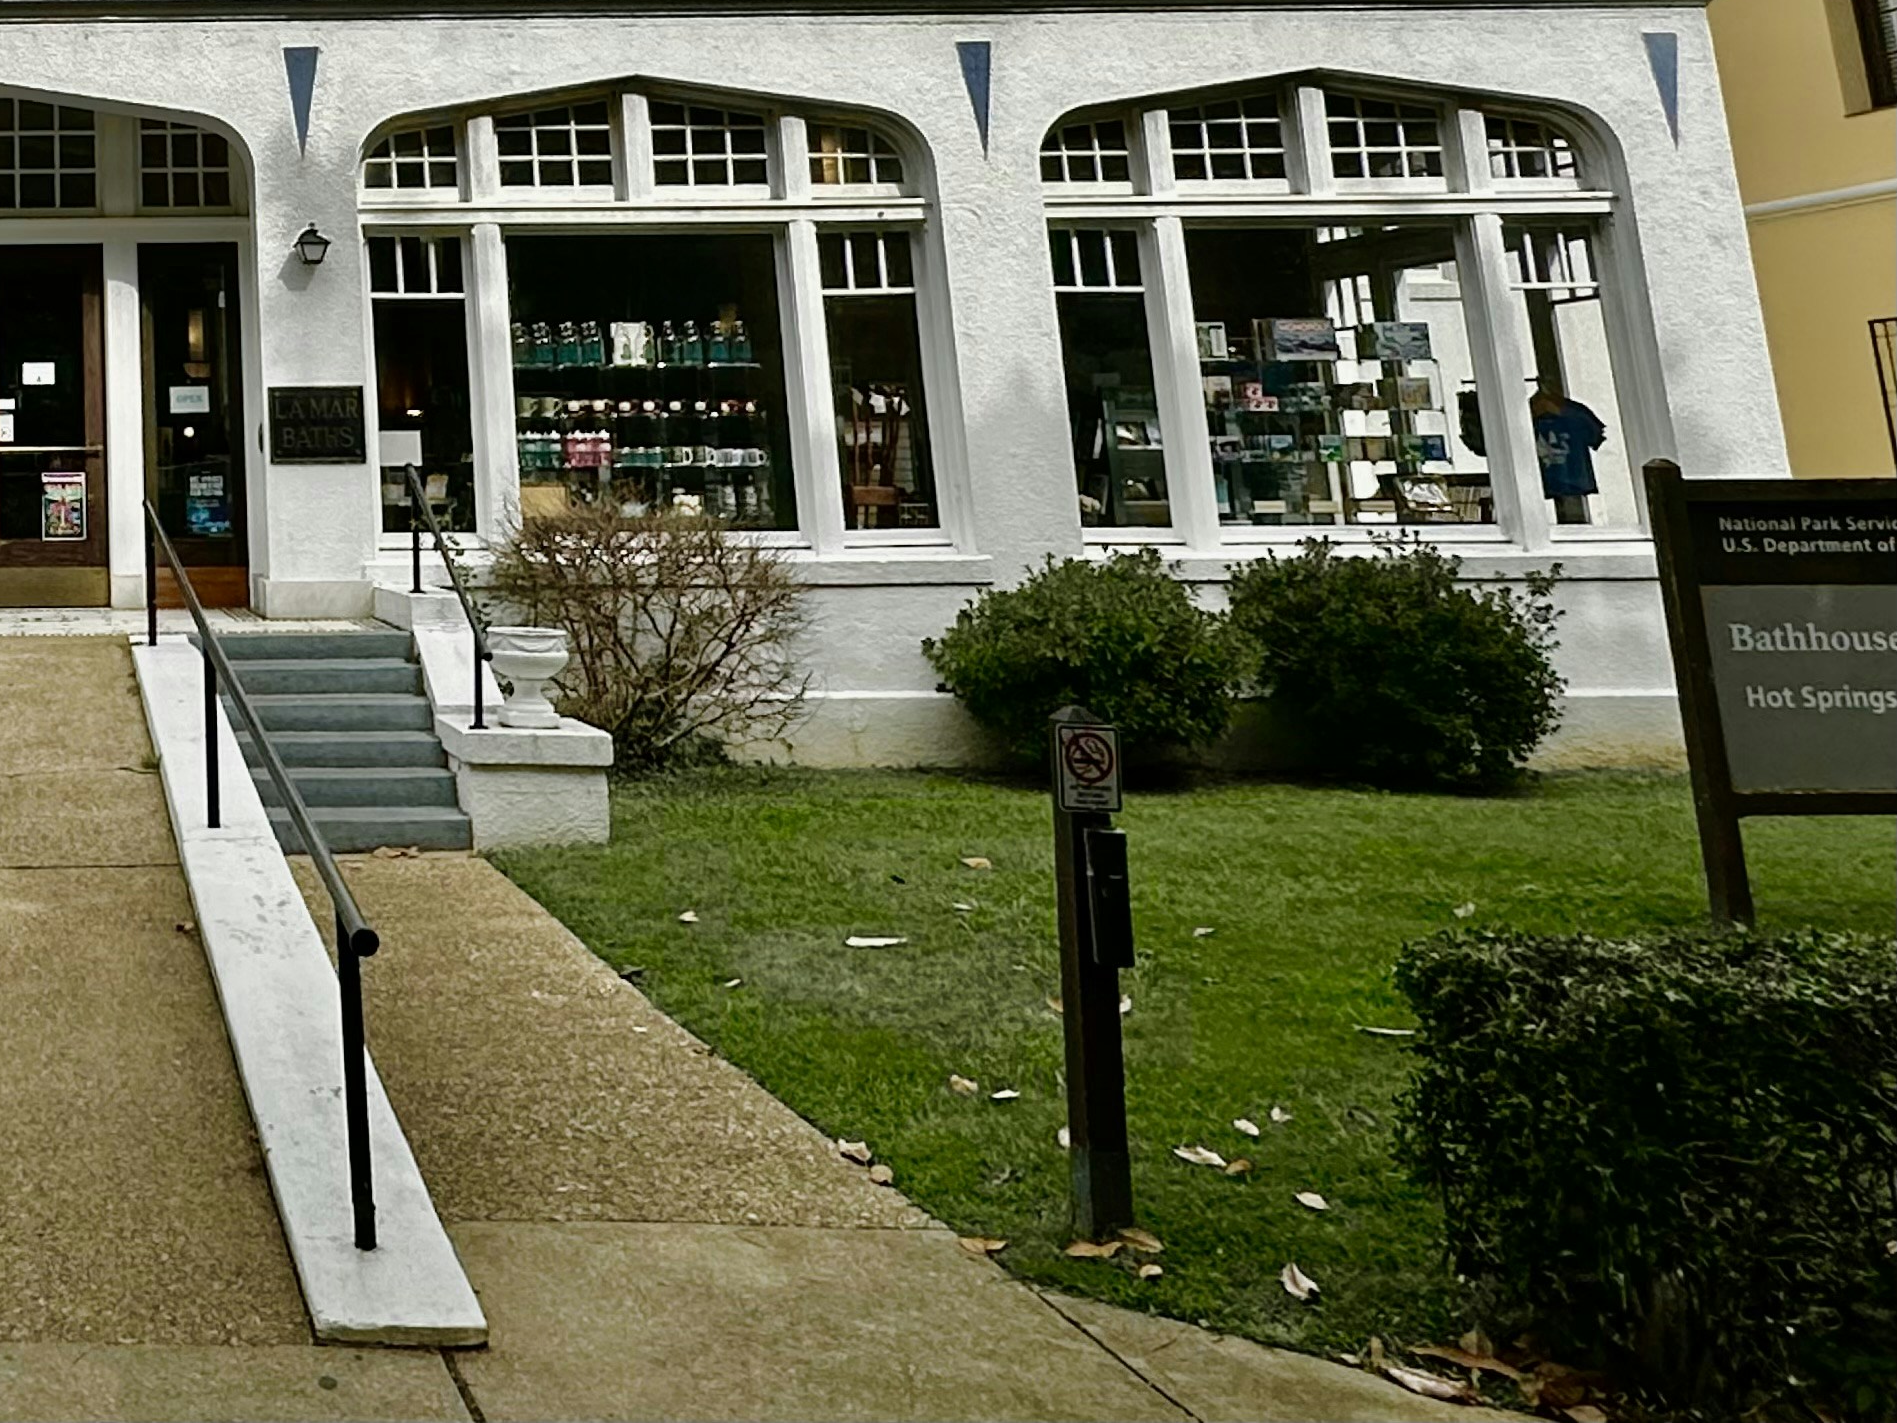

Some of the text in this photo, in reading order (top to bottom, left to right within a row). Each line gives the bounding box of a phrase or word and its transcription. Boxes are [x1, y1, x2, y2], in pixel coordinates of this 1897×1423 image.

[282, 427, 354, 447] BATHS
[1718, 516, 1796, 531] National
[1801, 516, 1842, 531] Park
[1722, 536, 1897, 556] U.S. Department of
[1728, 622, 1897, 652] Bathhouse
[1745, 684, 1897, 714] Hot Springs
